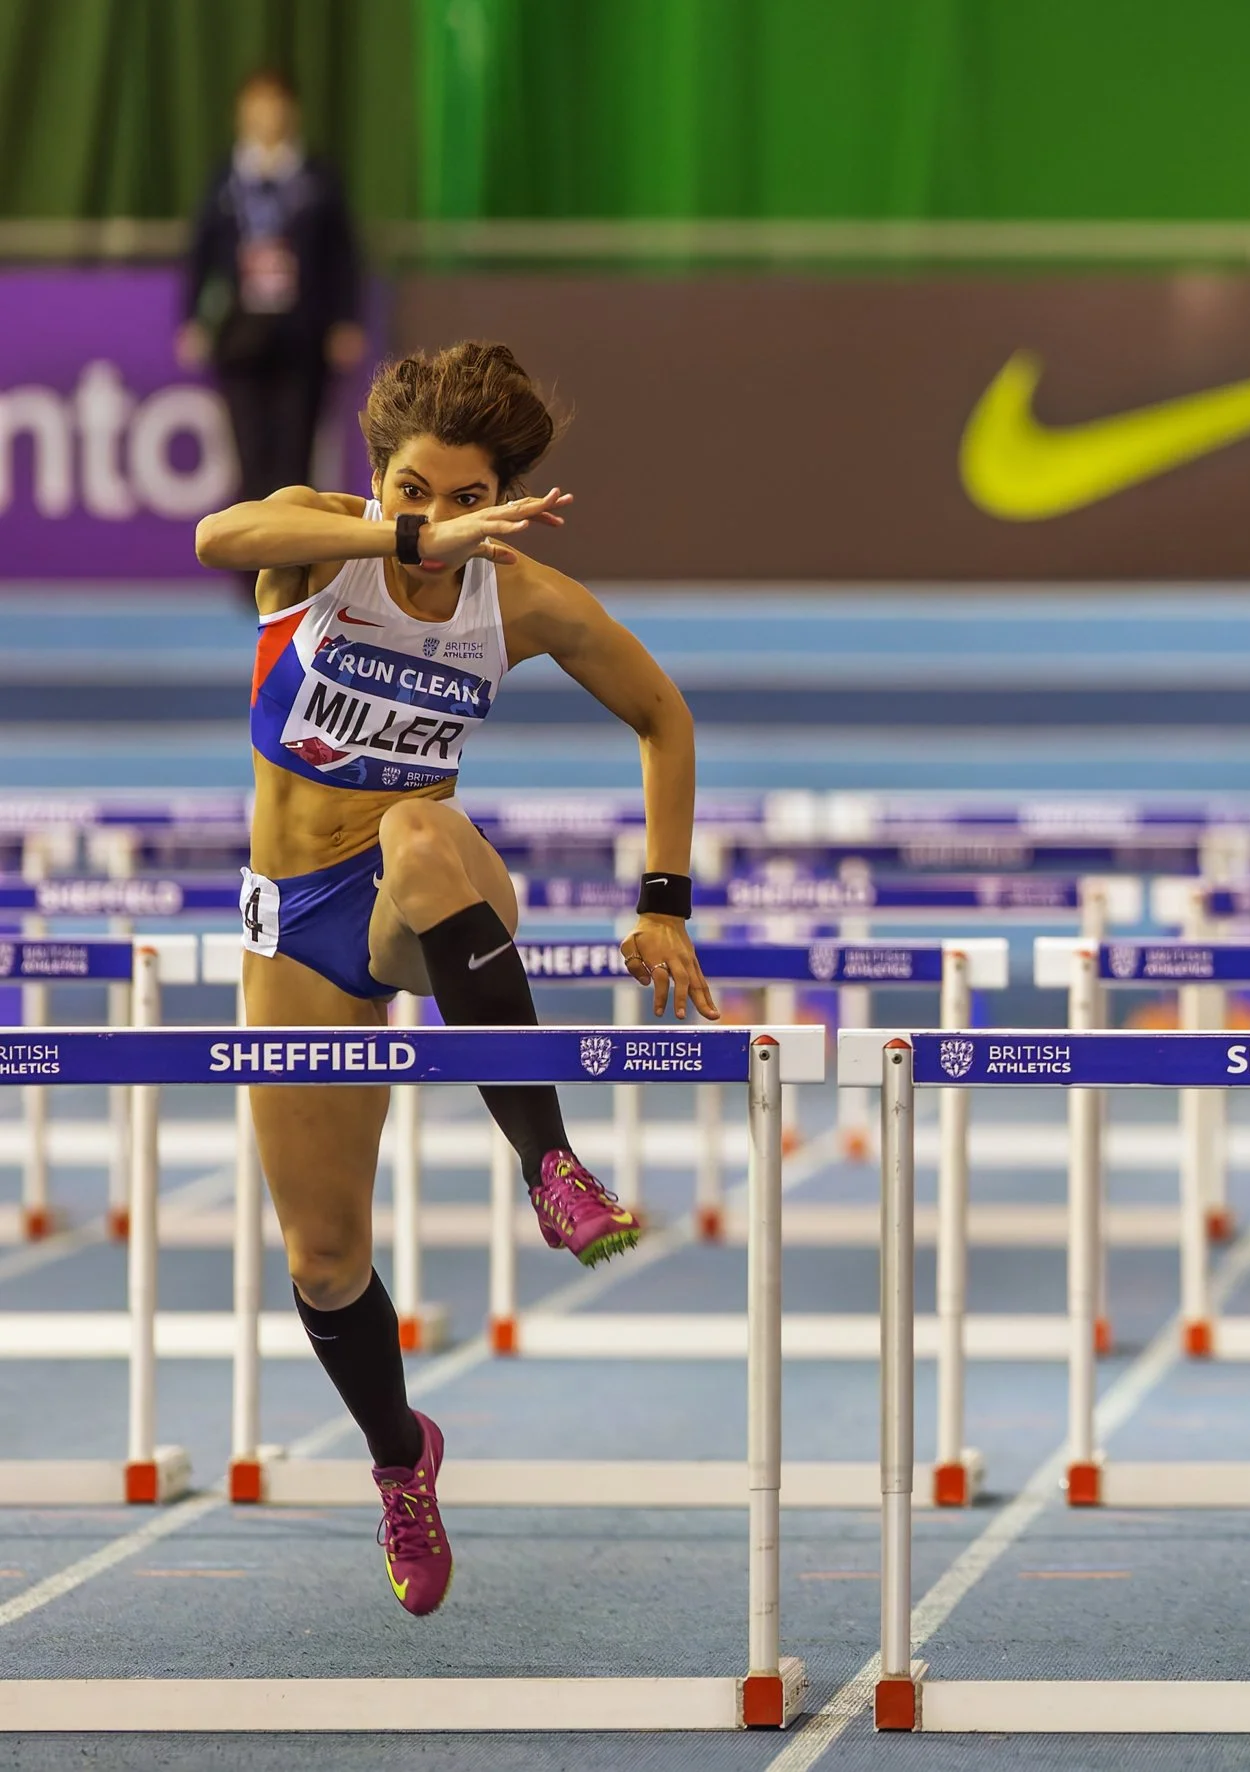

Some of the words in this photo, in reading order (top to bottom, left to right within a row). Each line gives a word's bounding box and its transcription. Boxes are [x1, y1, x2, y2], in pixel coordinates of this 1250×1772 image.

[445, 642, 484, 652] BRITISH
[443, 651, 484, 659] ATHLETICS
[338, 653, 394, 685] RUN
[399, 668, 480, 705] CLEAN
[303, 681, 465, 760] MILLER
[244, 887, 263, 941] 4
[0, 1045, 58, 1060] RITISH
[209, 1042, 416, 1072] SHEFFIELD
[625, 1042, 702, 1058] BRITISH
[989, 1045, 1071, 1060] BRITISH
[0, 1062, 60, 1075] HLETICS
[623, 1058, 703, 1072] ATHLETICS
[986, 1061, 1072, 1074] ATHLETICS
